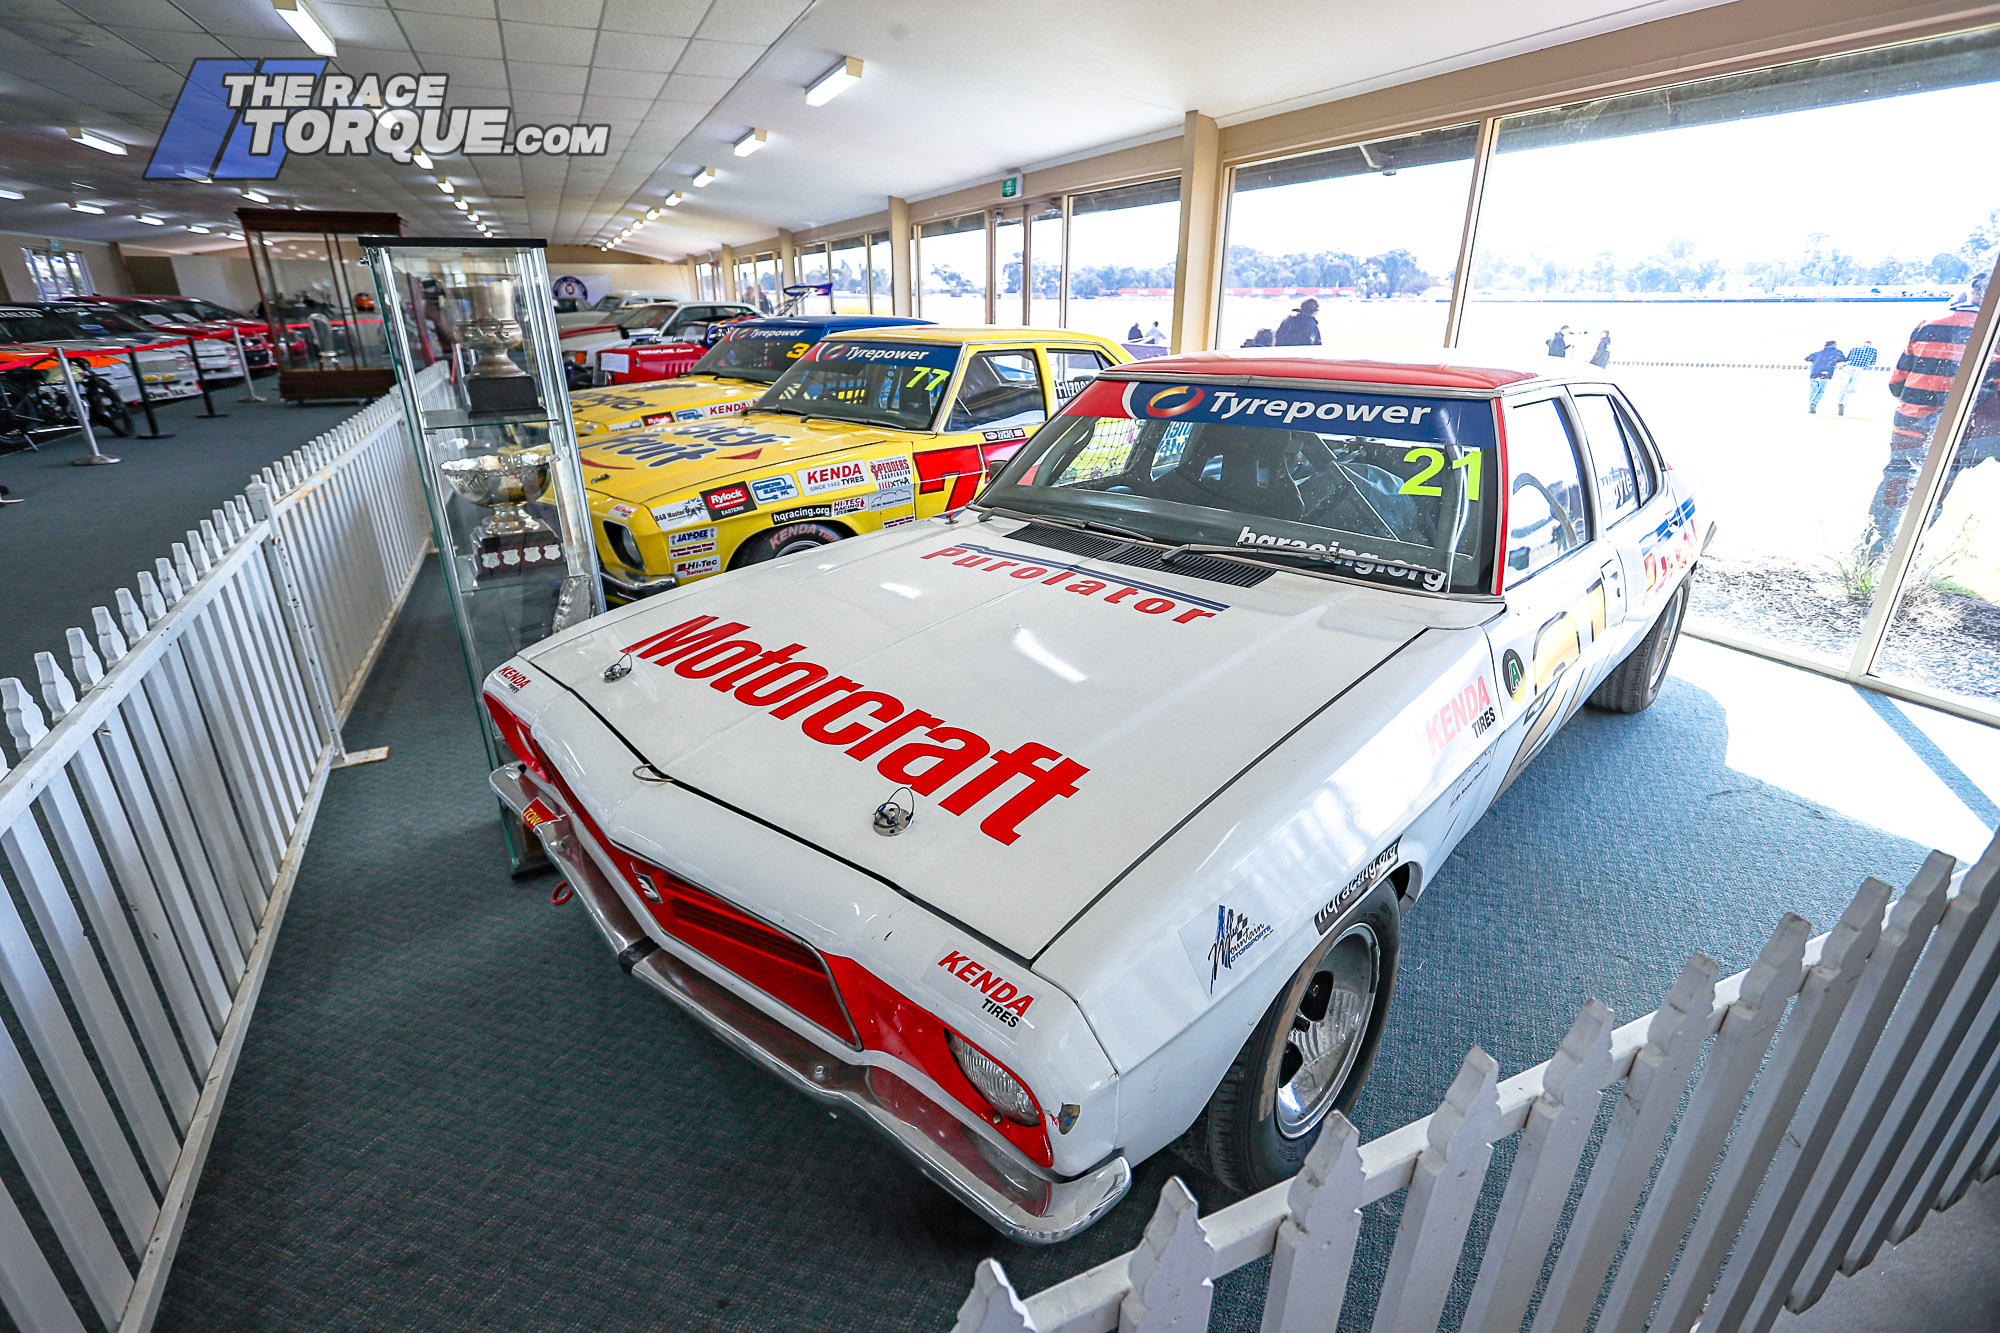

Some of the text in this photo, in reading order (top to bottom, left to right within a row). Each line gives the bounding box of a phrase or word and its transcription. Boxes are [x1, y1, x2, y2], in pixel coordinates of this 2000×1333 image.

[750, 327, 804, 339] Tyrepower
[786, 342, 810, 359] 3
[845, 346, 930, 361] Tyrepower
[905, 366, 951, 391] 77
[709, 402, 748, 415] KENDA
[1209, 390, 1432, 424] Tyrepower
[807, 463, 862, 484] KENDA
[877, 459, 910, 474] PEDDERS
[1398, 447, 1484, 501] 21
[809, 482, 827, 492] SINCE
[840, 475, 865, 486] TYRES
[710, 489, 744, 504] Rylock
[833, 497, 861, 508] HI-TEC
[720, 505, 745, 516] EASTERN
[773, 506, 830, 522] hqracing.org
[833, 504, 860, 512] RACING
[676, 528, 709, 542] JAY-DEE
[769, 523, 817, 551] KENDA
[687, 559, 718, 570] Hi-Tec
[920, 547, 1218, 624] Purolator
[499, 665, 532, 689] KENDA
[1425, 675, 1491, 757] KENDA
[1471, 706, 1497, 739] TIRES
[619, 614, 1091, 847] Motorcraft
[523, 807, 544, 827] TOW
[937, 950, 1035, 1018] KENDA
[981, 998, 1020, 1028] TIRES
